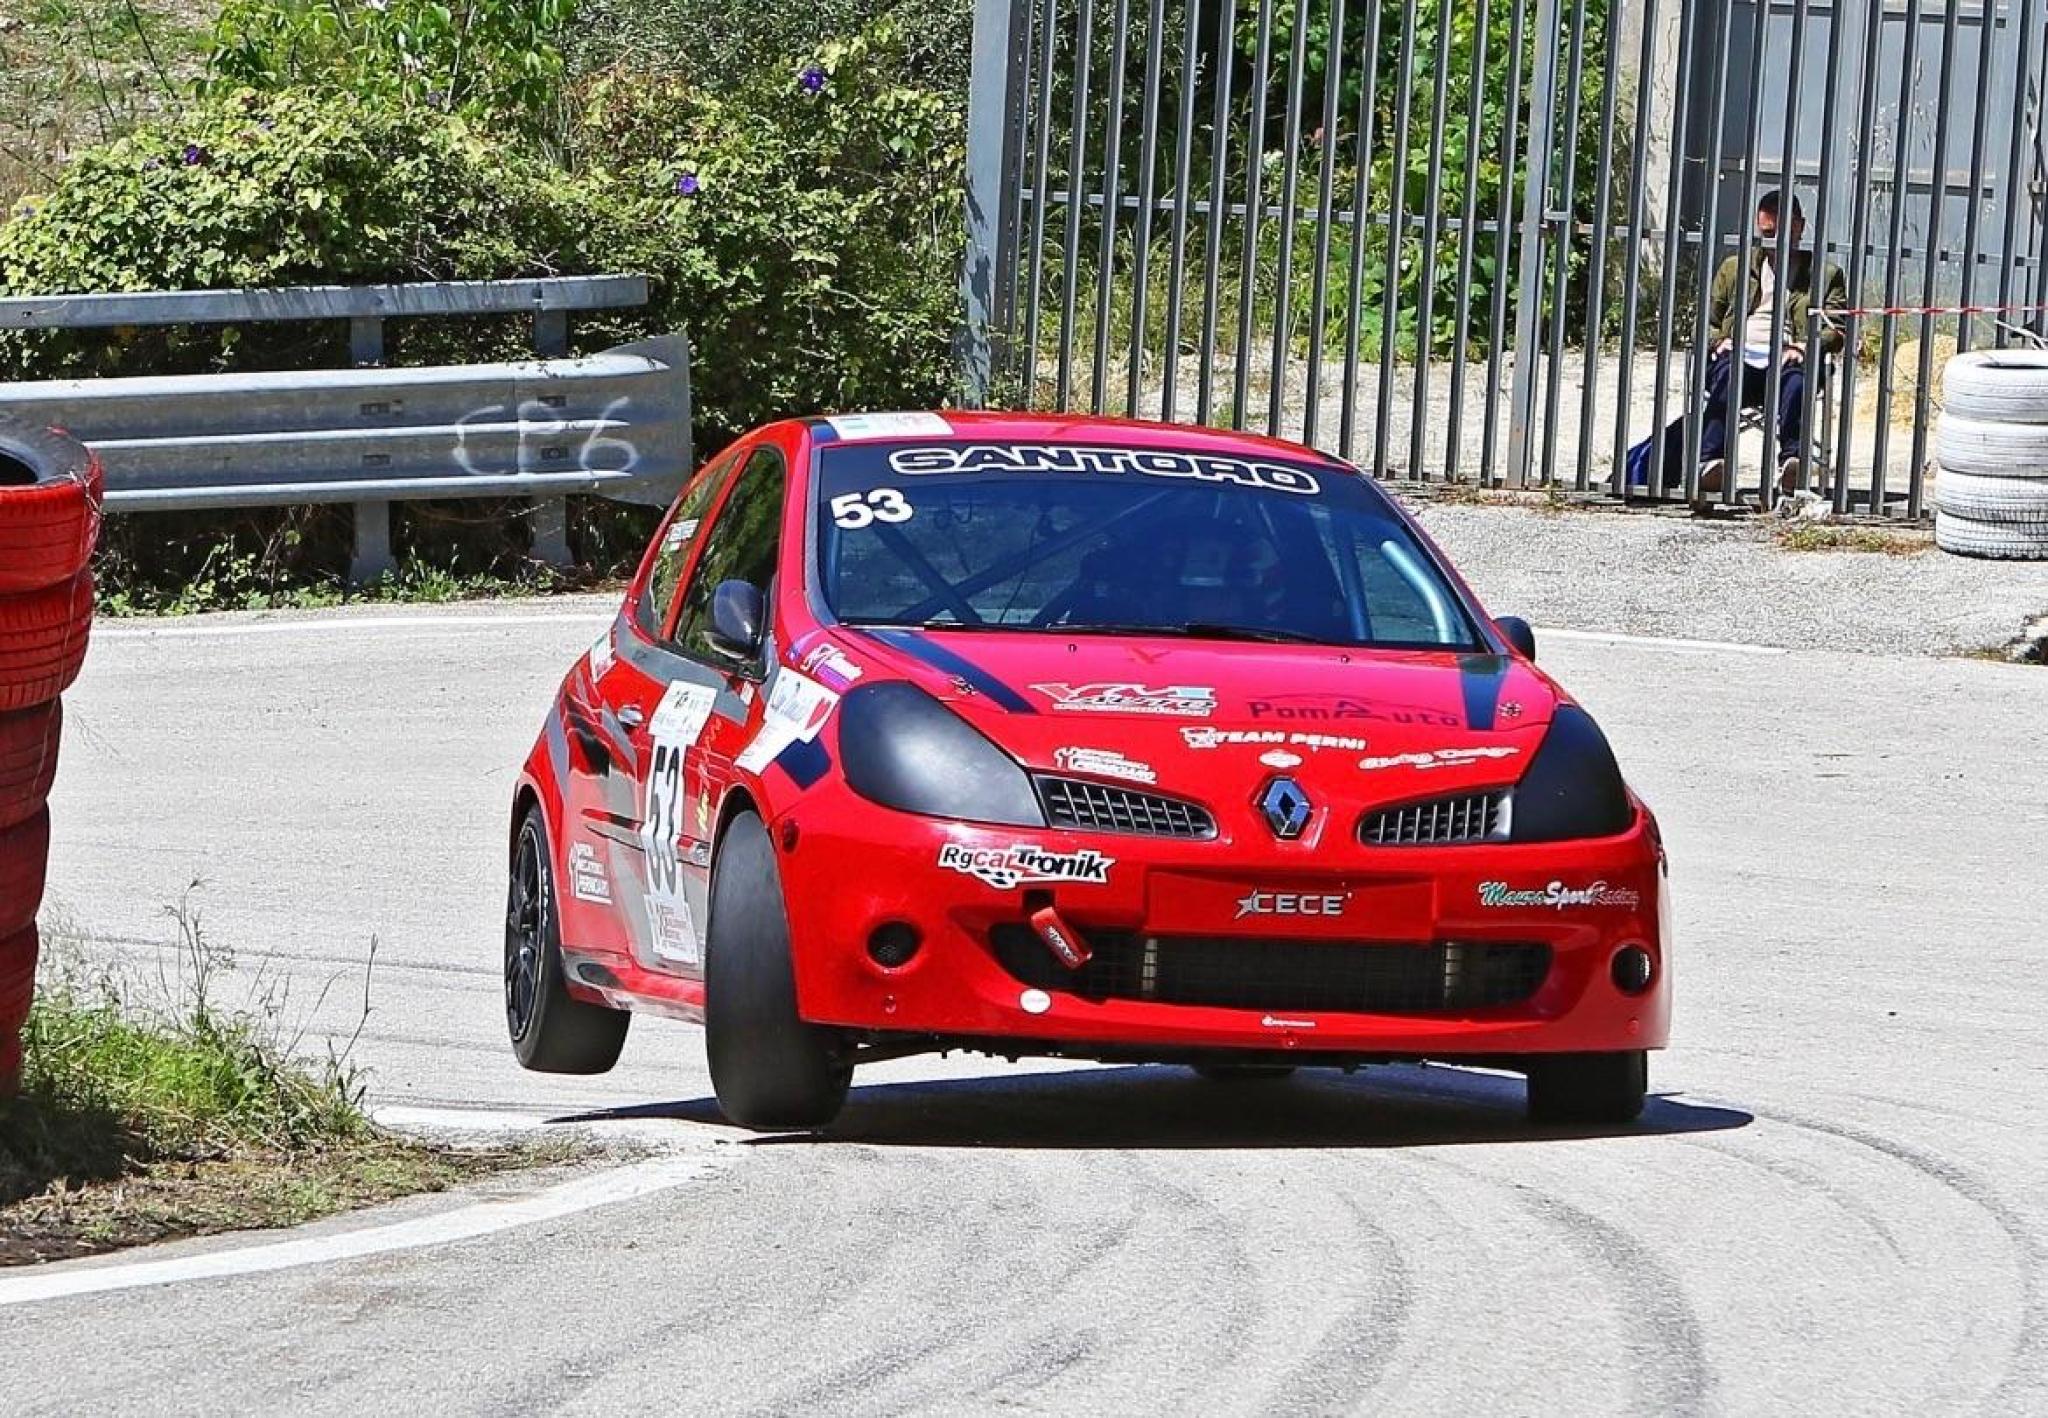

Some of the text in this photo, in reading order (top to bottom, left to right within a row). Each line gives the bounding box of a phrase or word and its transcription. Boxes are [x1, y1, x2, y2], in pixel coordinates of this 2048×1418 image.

[889, 446, 1321, 494] SANTORO
[831, 489, 914, 528] 53
[1217, 730, 1366, 749] TEAM PERNI
[650, 746, 680, 895] 53
[1252, 894, 1344, 915] CECE
